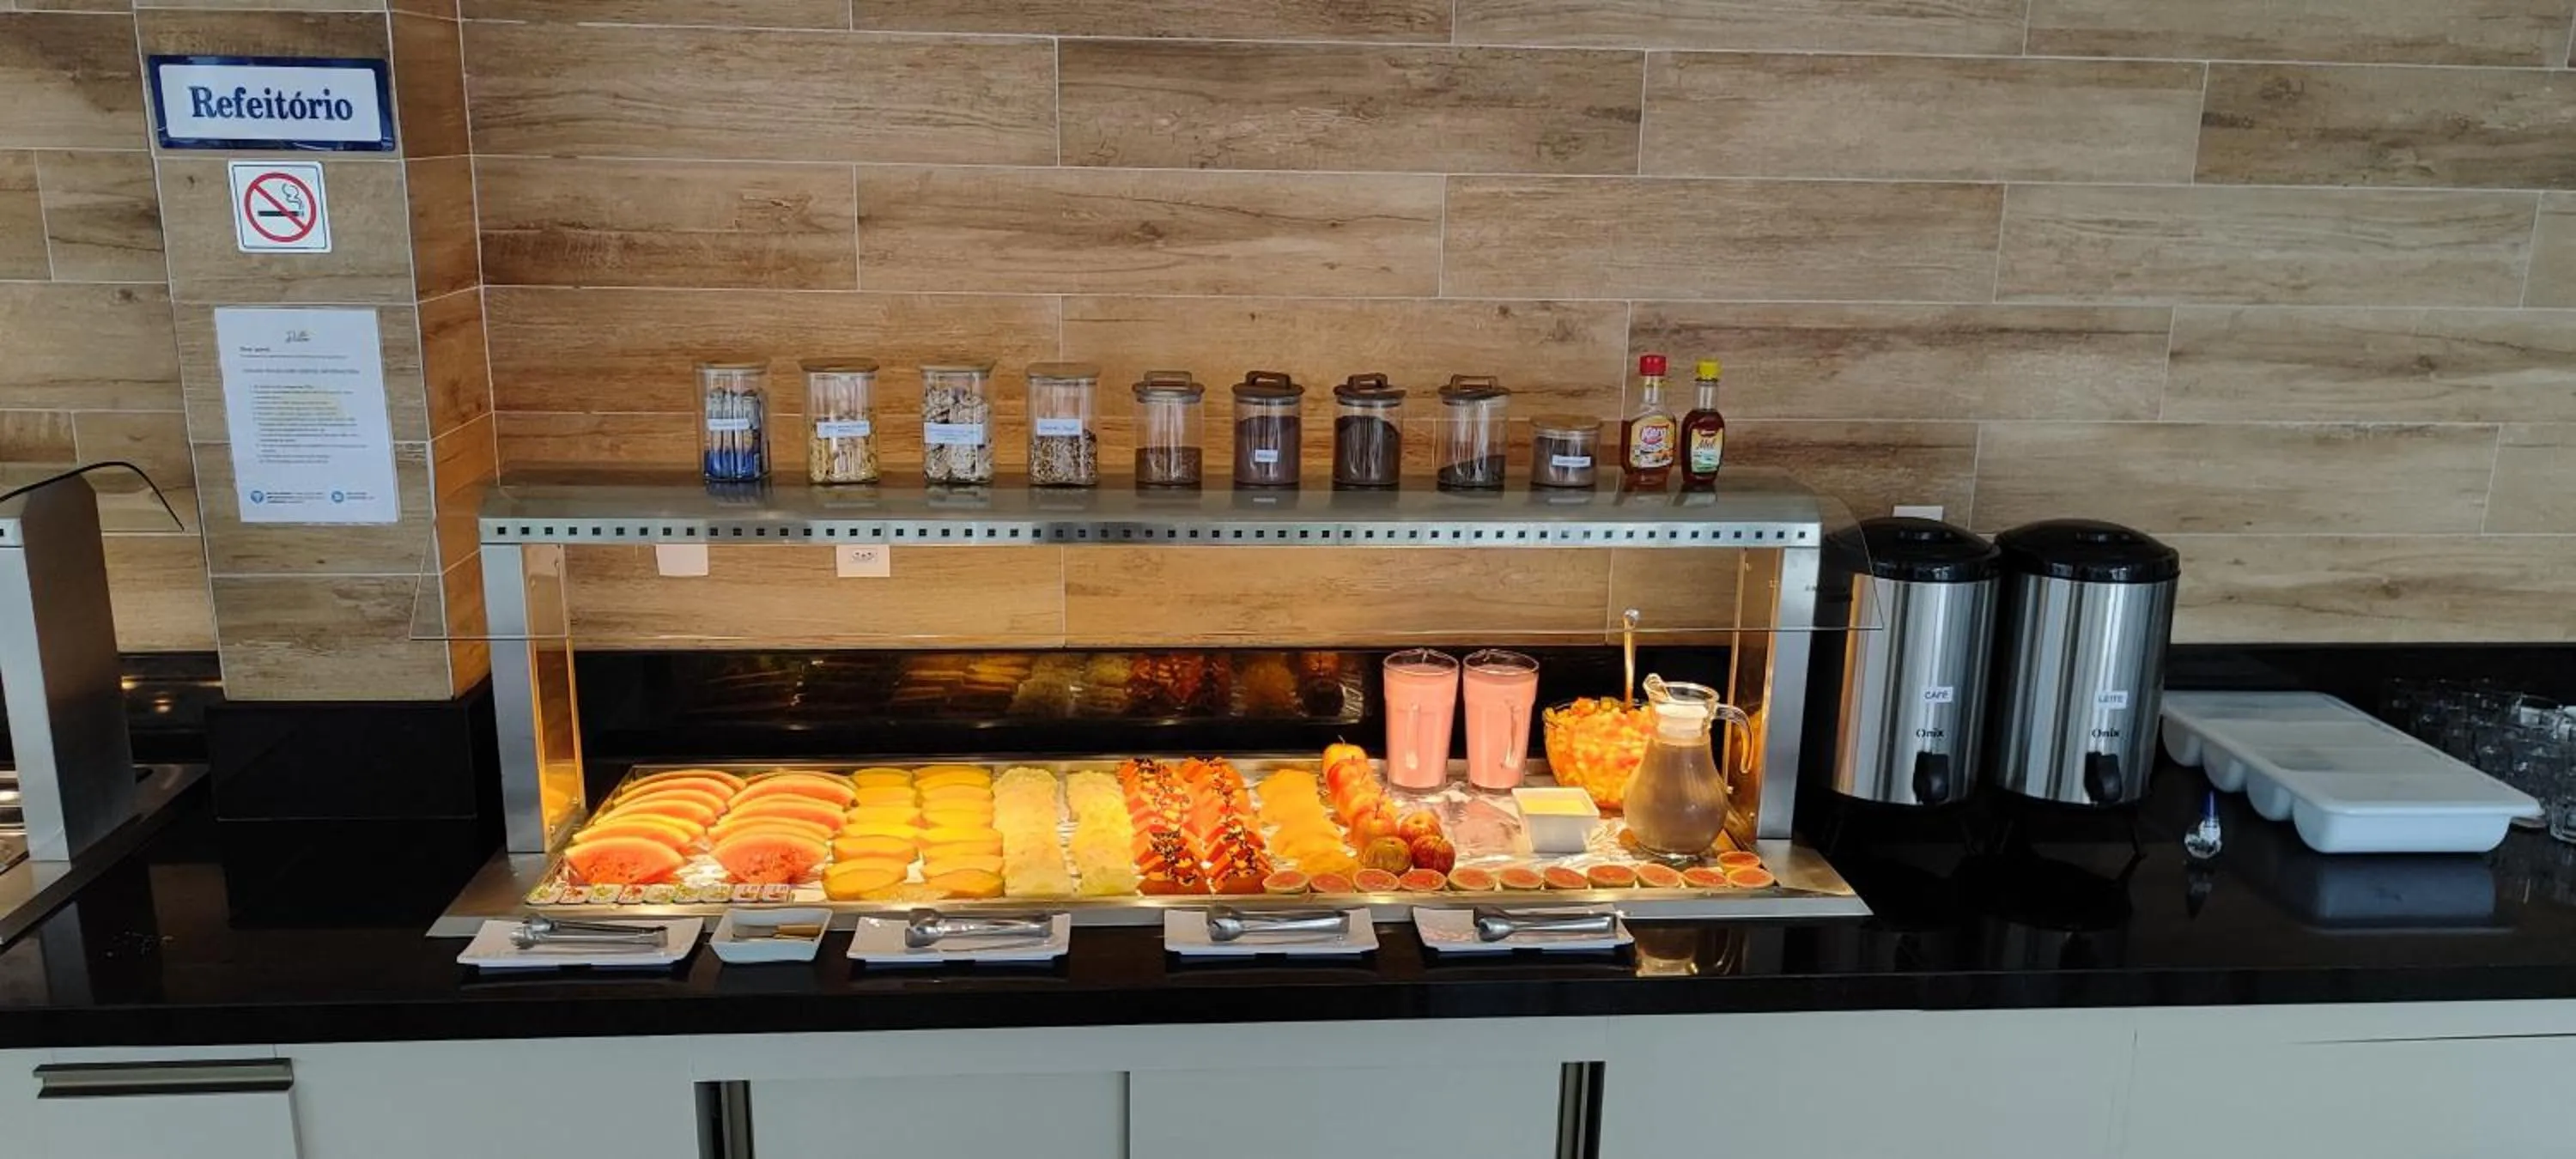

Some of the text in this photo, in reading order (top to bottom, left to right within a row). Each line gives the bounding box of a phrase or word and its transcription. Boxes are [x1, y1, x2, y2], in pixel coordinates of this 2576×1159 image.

[188, 86, 353, 121] Refeitório
[1916, 727, 1945, 738] Onix
[2091, 727, 2120, 738] Onix
